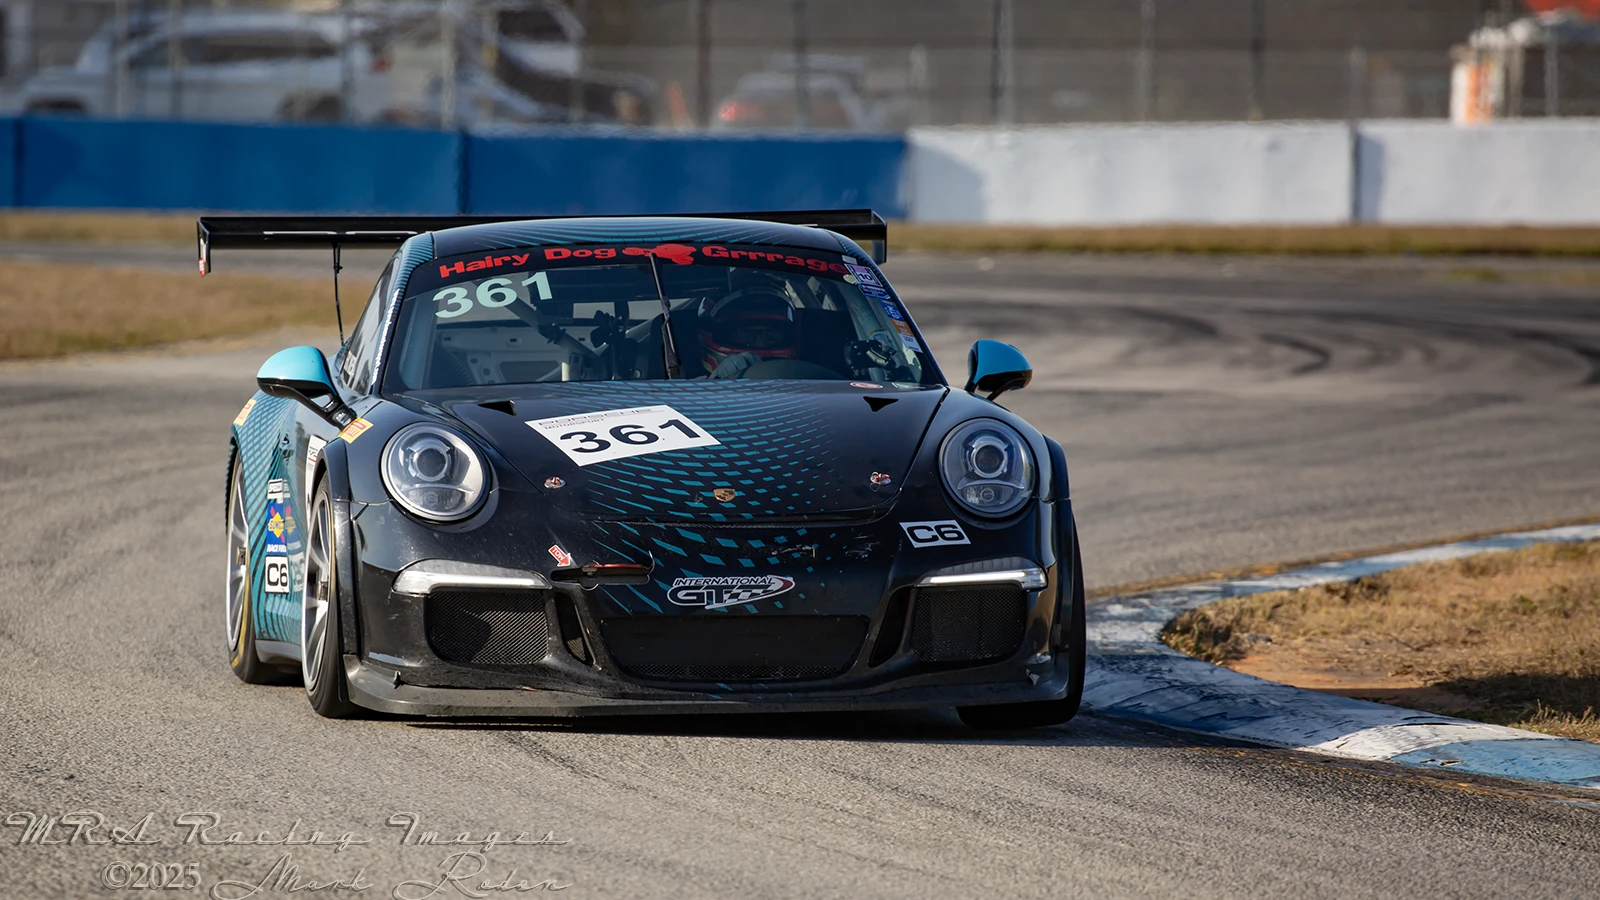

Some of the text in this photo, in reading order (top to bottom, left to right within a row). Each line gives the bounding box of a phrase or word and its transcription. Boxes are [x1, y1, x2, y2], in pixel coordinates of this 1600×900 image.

[439, 245, 849, 278] Hairy Dog Grrrage
[432, 271, 553, 318] 361
[560, 419, 701, 454] 361
[906, 524, 965, 543] C6
[551, 546, 566, 562] TOW
[267, 563, 288, 587] C6
[673, 576, 776, 586] INTERNATIONAL
